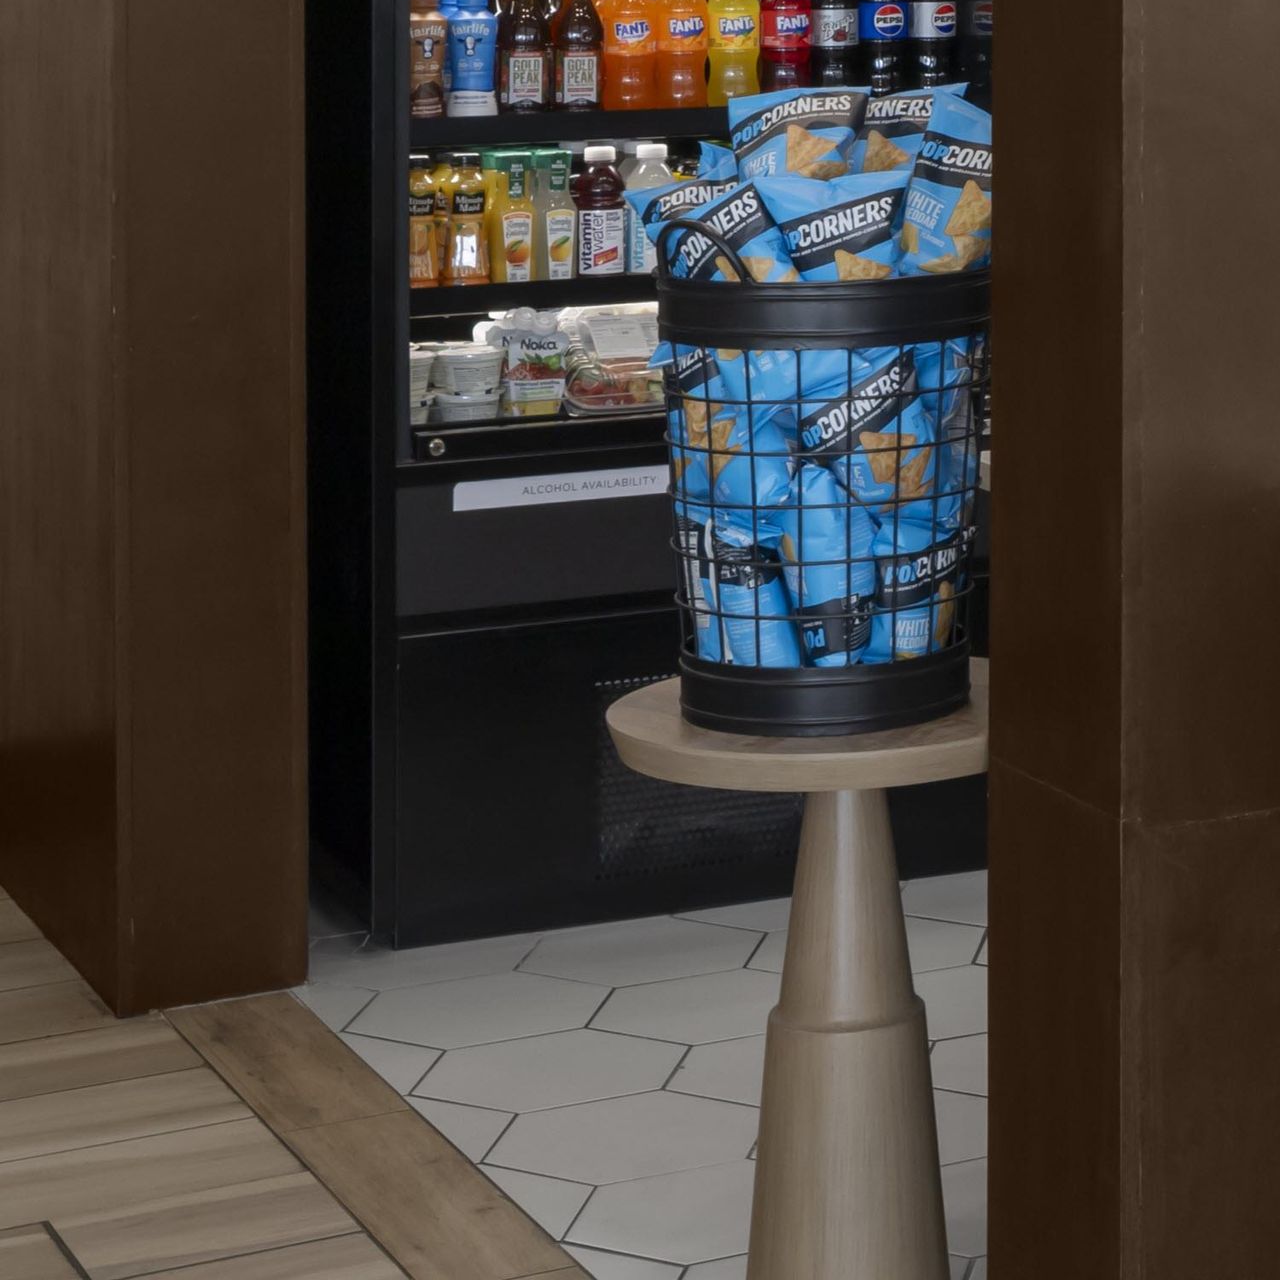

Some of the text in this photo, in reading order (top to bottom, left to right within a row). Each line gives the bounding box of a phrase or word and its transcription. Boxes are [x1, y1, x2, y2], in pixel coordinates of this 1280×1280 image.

[512, 59, 541, 71] GOLD
[567, 59, 595, 71] GOLD
[512, 71, 541, 84] PEAK
[567, 71, 595, 84] PEAK
[582, 212, 604, 271] vitamin water
[519, 337, 557, 351] Noka
[522, 475, 658, 495] ALCOHOL AVAILABILITY
